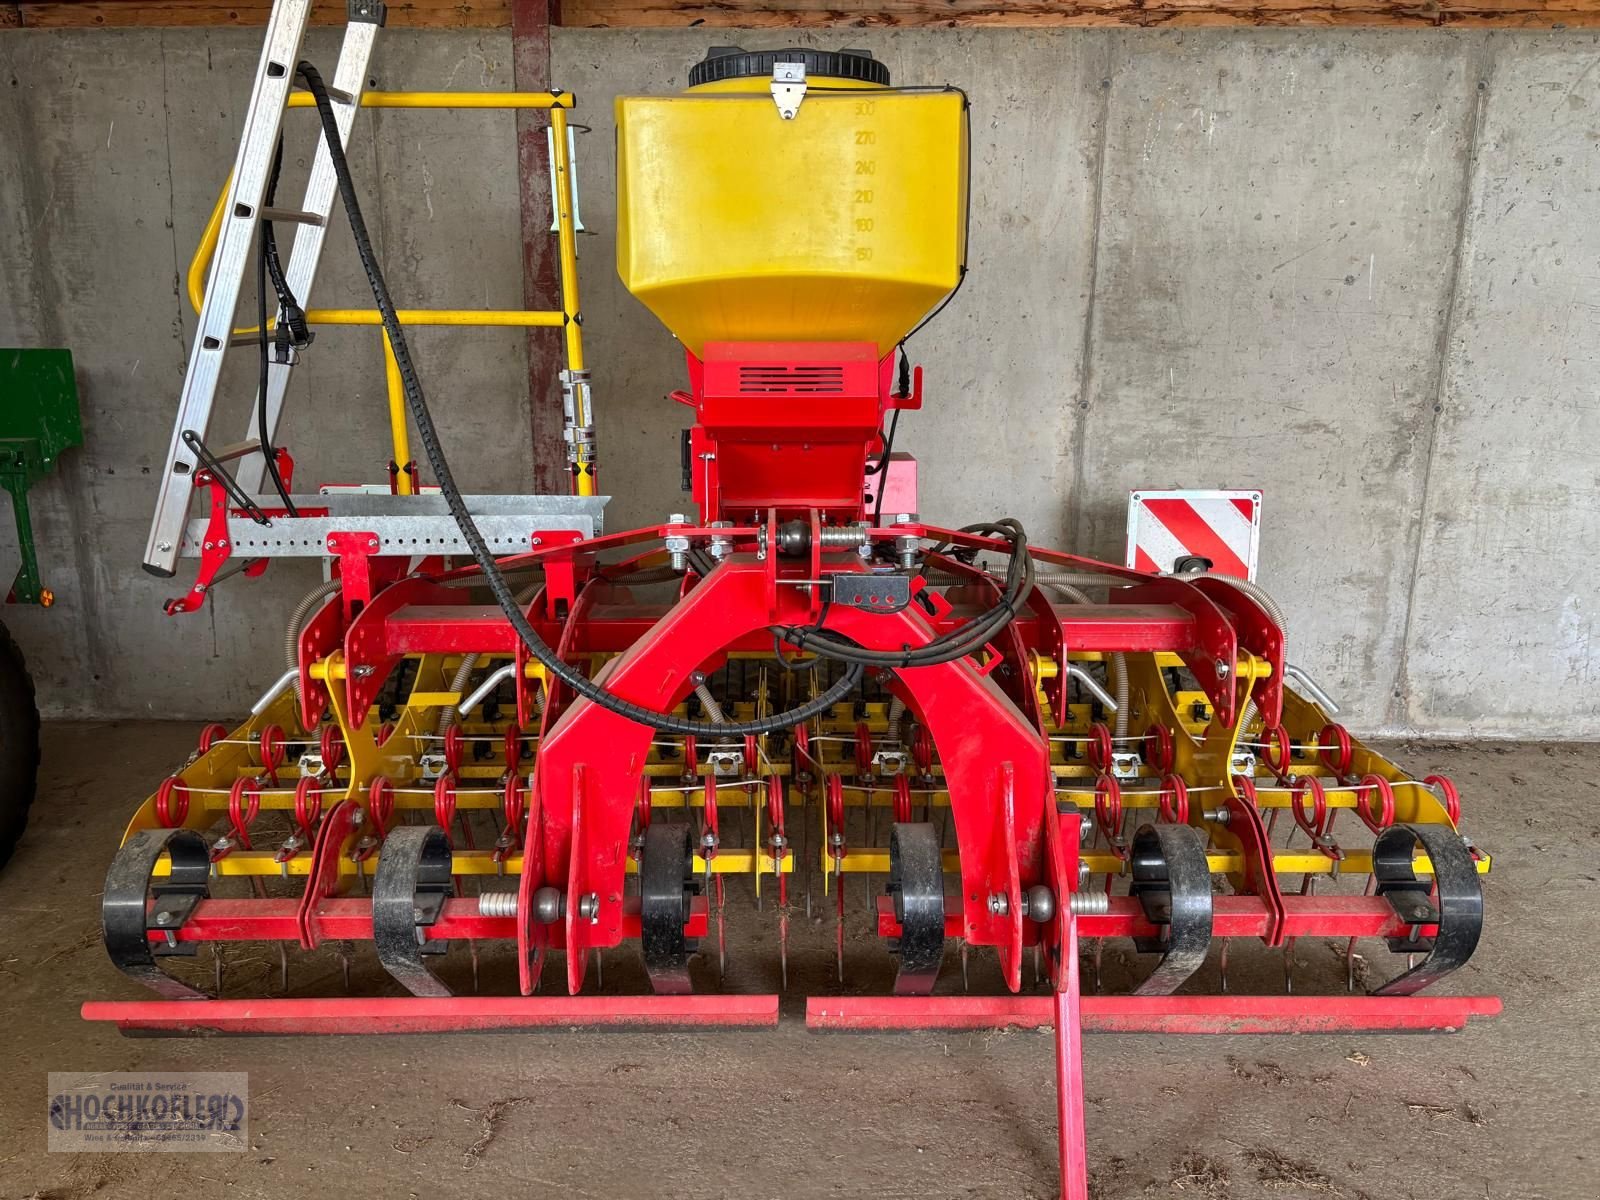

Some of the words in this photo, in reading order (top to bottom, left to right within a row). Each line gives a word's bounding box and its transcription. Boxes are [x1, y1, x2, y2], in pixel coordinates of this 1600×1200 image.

[855, 131, 876, 145] 270
[855, 160, 876, 175] 240
[855, 190, 874, 204] 210
